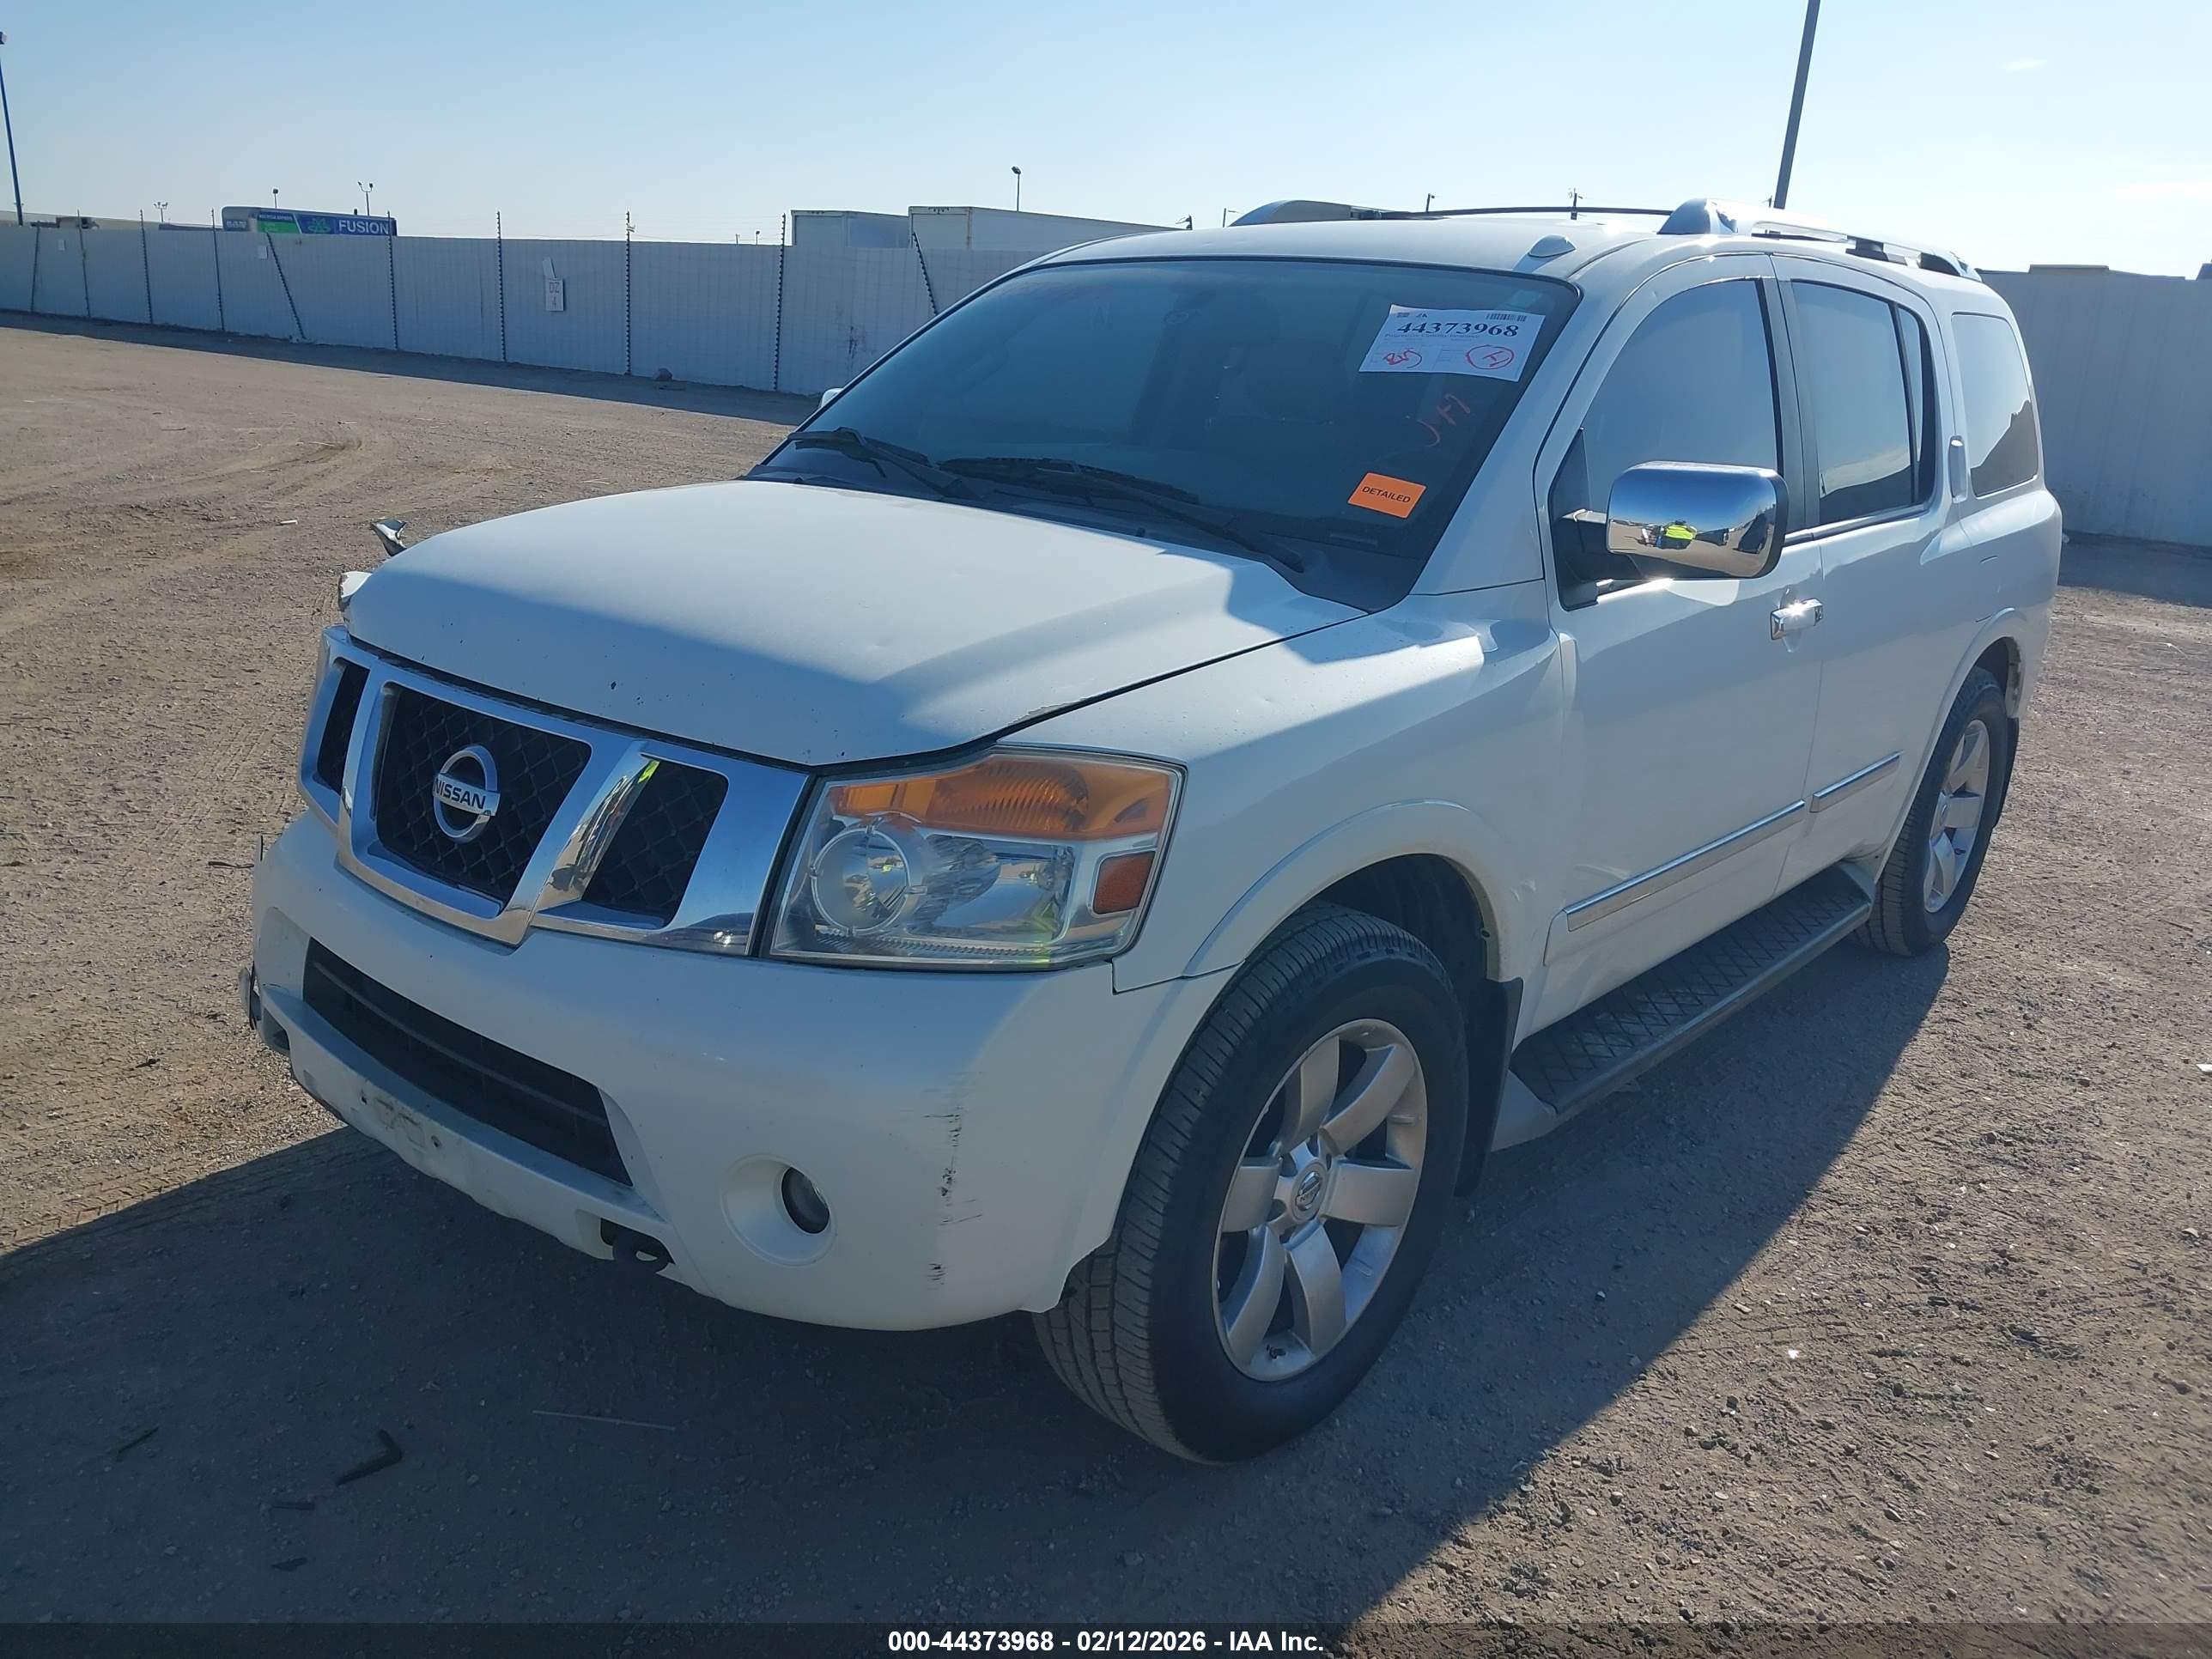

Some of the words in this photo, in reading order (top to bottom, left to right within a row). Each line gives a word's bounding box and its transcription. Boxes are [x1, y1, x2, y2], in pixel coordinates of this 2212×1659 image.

[338, 219, 390, 234] FUSION
[1397, 322, 1519, 337] 44373968
[1362, 486, 1411, 502] DETAILED
[434, 778, 486, 809] NISSAN
